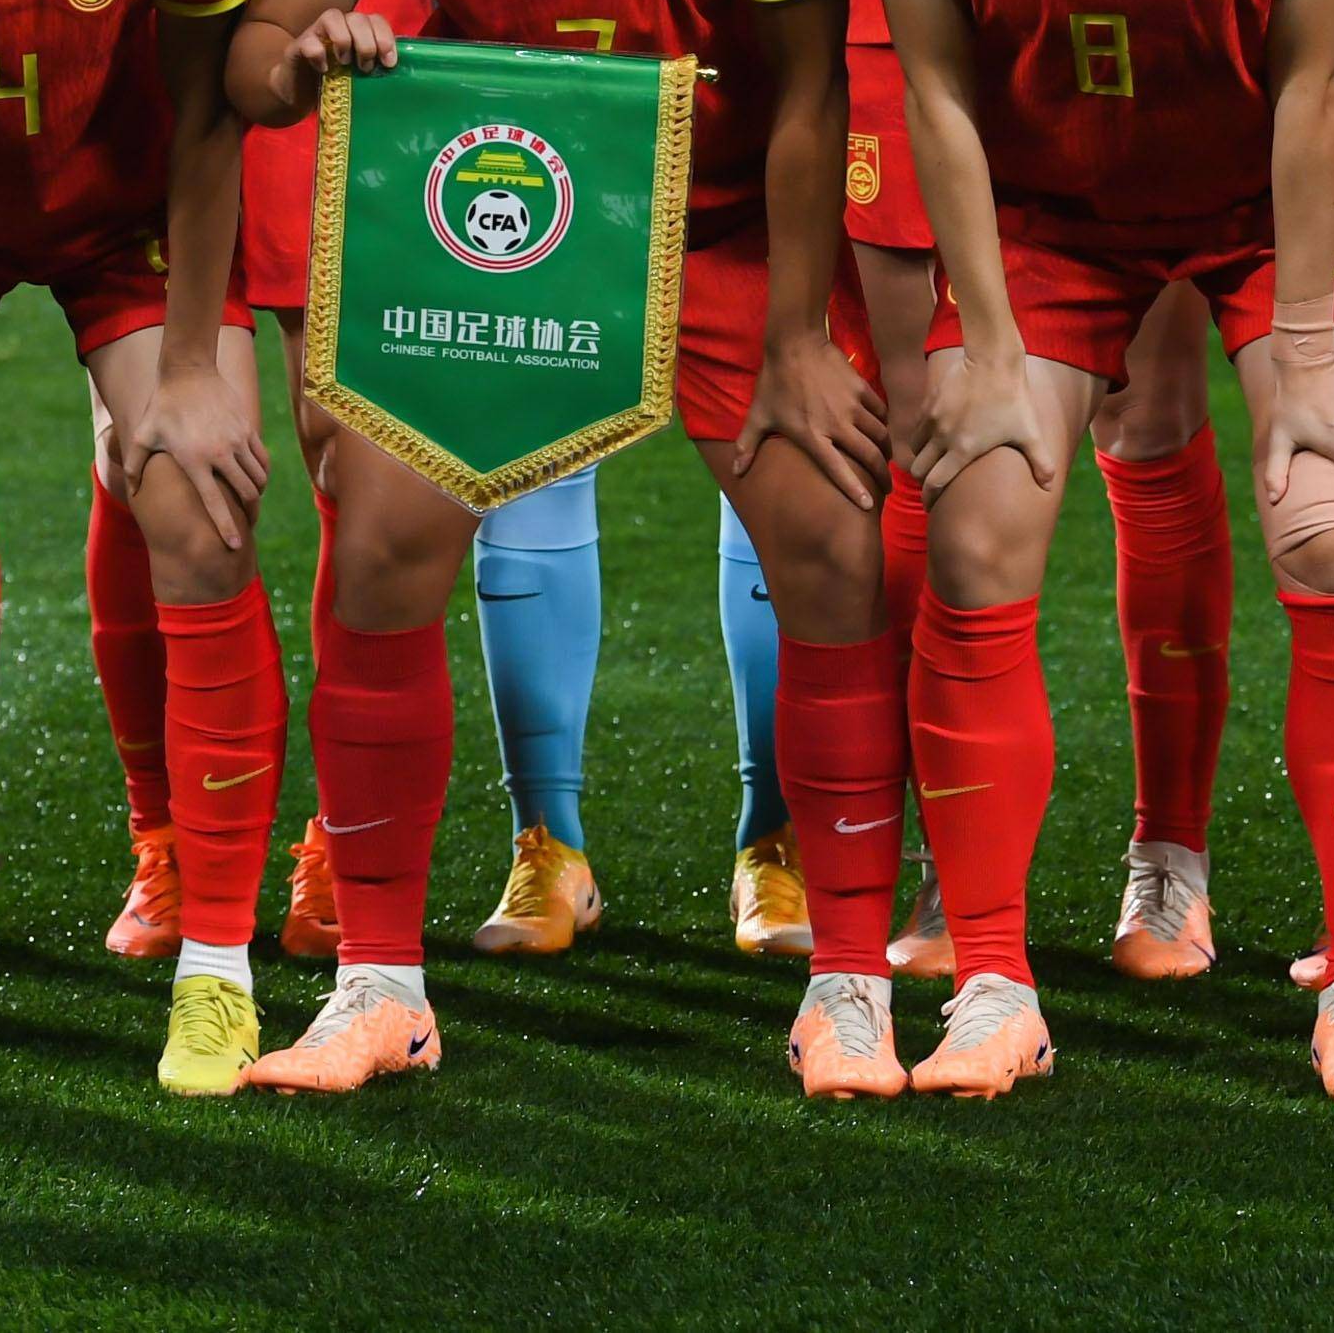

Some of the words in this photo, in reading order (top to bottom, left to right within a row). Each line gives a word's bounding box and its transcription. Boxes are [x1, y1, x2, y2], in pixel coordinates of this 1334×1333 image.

[1069, 13, 1134, 98] 8
[438, 126, 565, 174] 中国足球协会
[478, 213, 518, 233] CFA
[382, 305, 602, 355] 中国足球协会
[380, 342, 436, 358] CHINESE
[441, 347, 509, 364] FOOTBALL
[514, 354, 600, 371] ASSOCIATION
